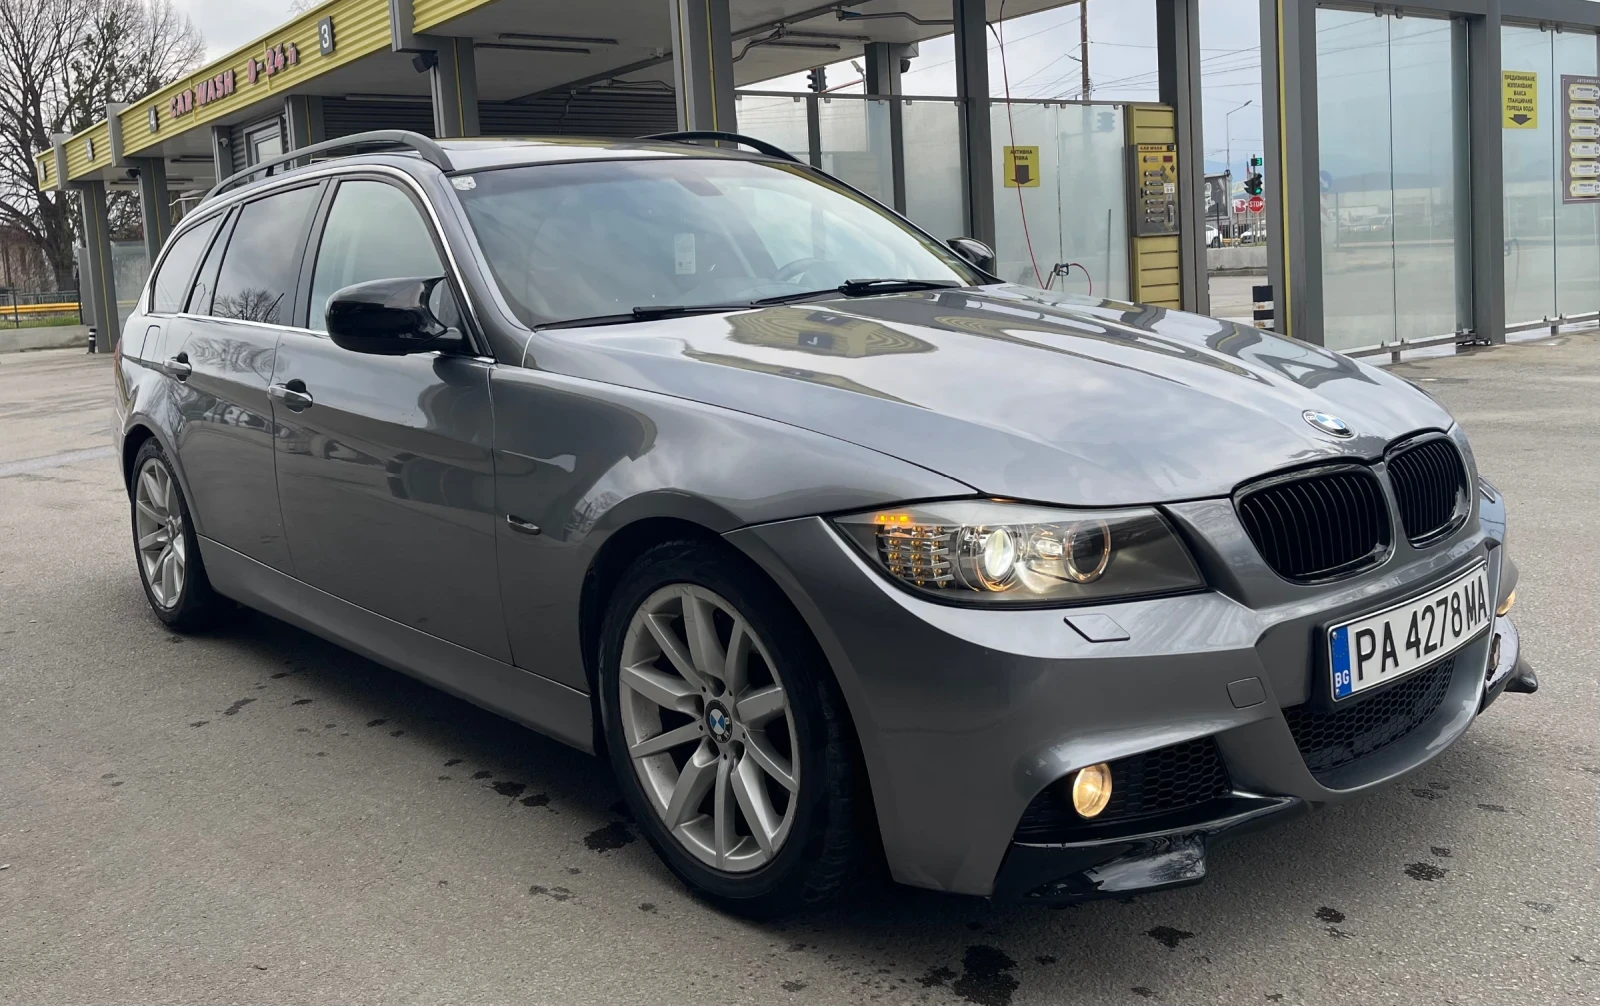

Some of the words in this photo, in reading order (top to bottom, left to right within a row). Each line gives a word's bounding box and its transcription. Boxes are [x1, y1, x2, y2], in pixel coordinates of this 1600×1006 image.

[321, 24, 330, 48] 3
[169, 90, 193, 118] CAR
[195, 69, 235, 107] WASH
[1256, 158, 1262, 166] 3
[1355, 620, 1399, 681] PA
[1405, 591, 1463, 659] 4278
[1464, 575, 1488, 631] MA
[1335, 669, 1350, 688] BG
